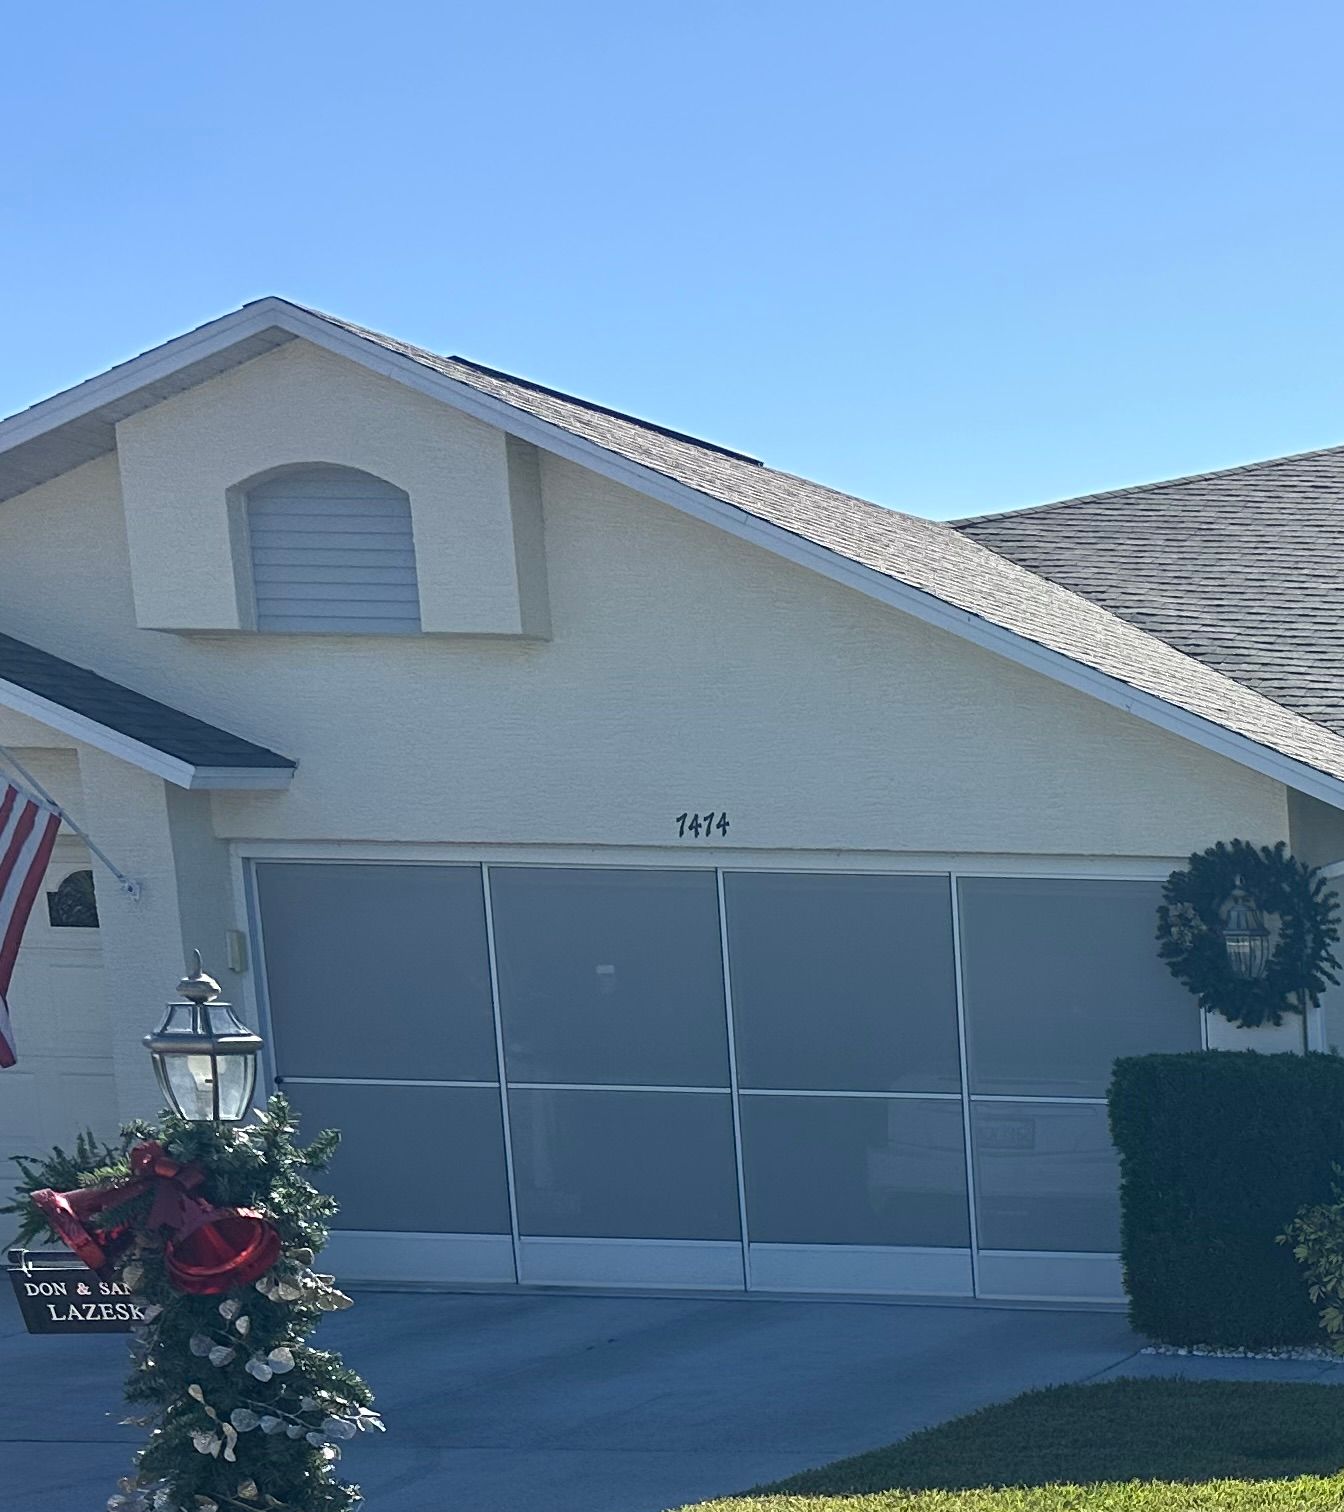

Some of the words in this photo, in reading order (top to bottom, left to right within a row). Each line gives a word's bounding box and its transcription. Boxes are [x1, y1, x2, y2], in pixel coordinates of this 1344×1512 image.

[676, 812, 730, 838] 7474
[24, 1282, 67, 1296] DON
[76, 1282, 92, 1296] &
